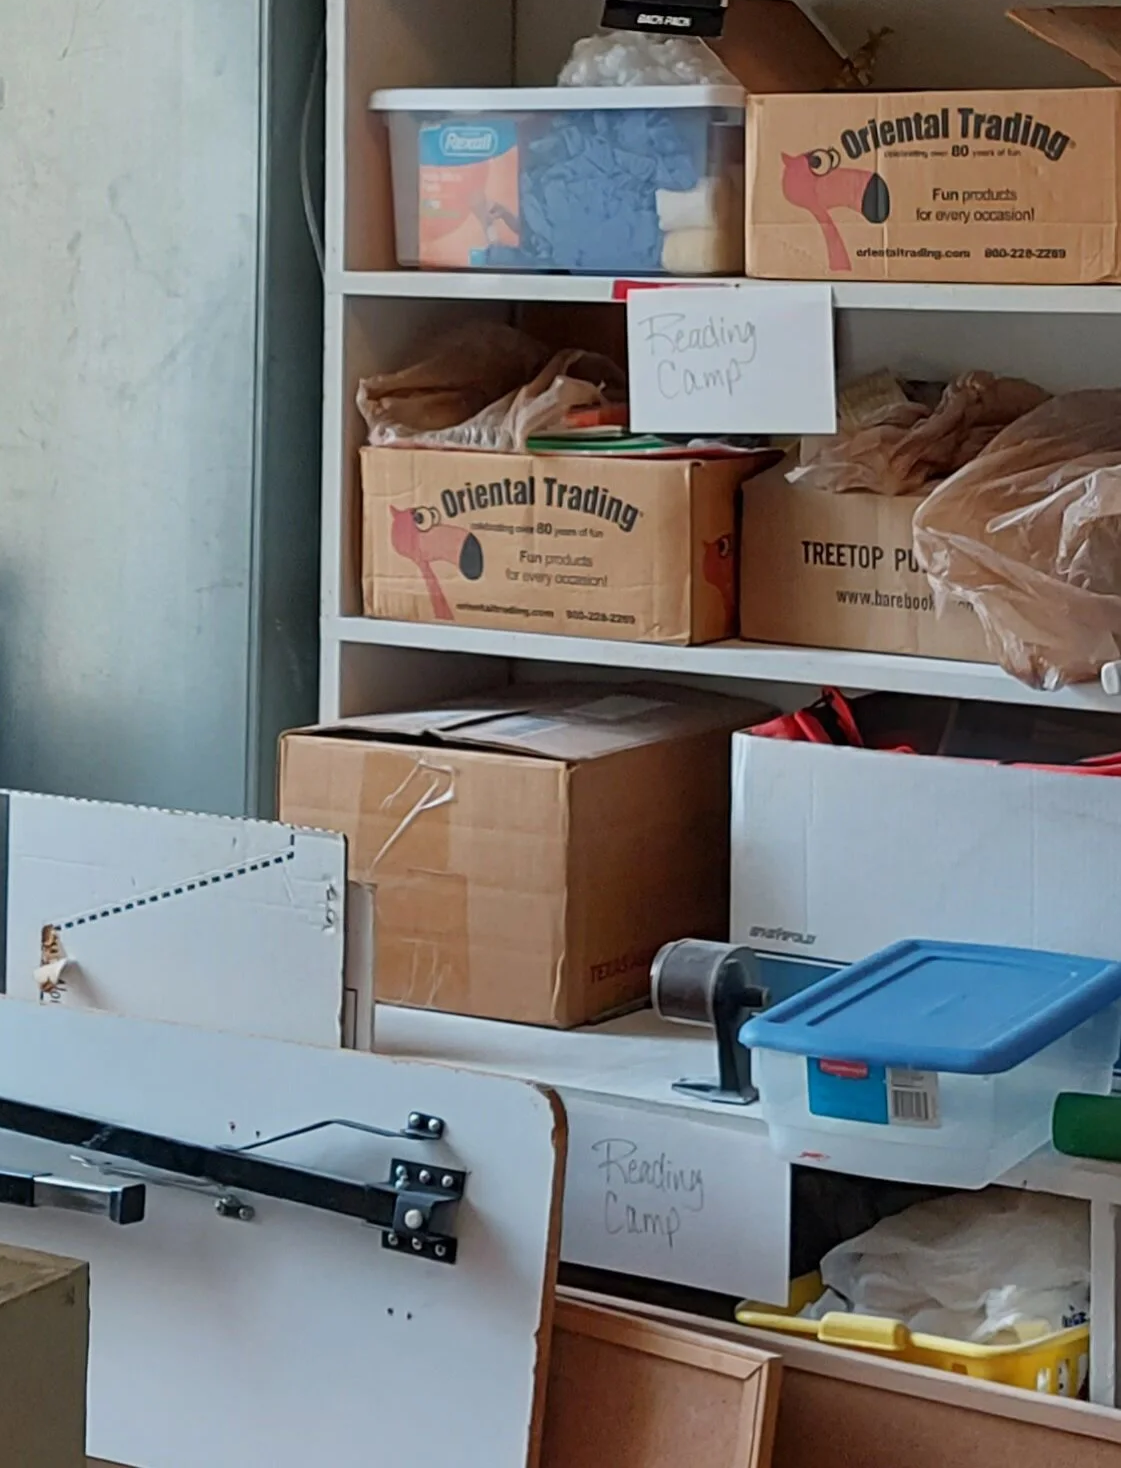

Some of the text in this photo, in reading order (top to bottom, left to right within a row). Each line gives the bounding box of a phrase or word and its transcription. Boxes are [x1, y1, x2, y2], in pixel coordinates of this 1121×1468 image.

[841, 107, 1071, 162] Oriental Trading
[951, 144, 969, 157] 80
[932, 188, 1017, 204] Fun products
[916, 208, 1035, 224] for every occasion!
[856, 247, 971, 260] orientaltrading.com
[638, 313, 757, 364] Reading
[657, 359, 742, 400] Camp
[440, 476, 639, 533] Oriental Trading
[536, 522, 553, 535] 80
[520, 550, 593, 568] Fun products
[801, 540, 926, 574] TREETOP PU
[505, 568, 608, 587] for every occasion!
[591, 1138, 704, 1212] Reading
[604, 1190, 680, 1249] Camp
